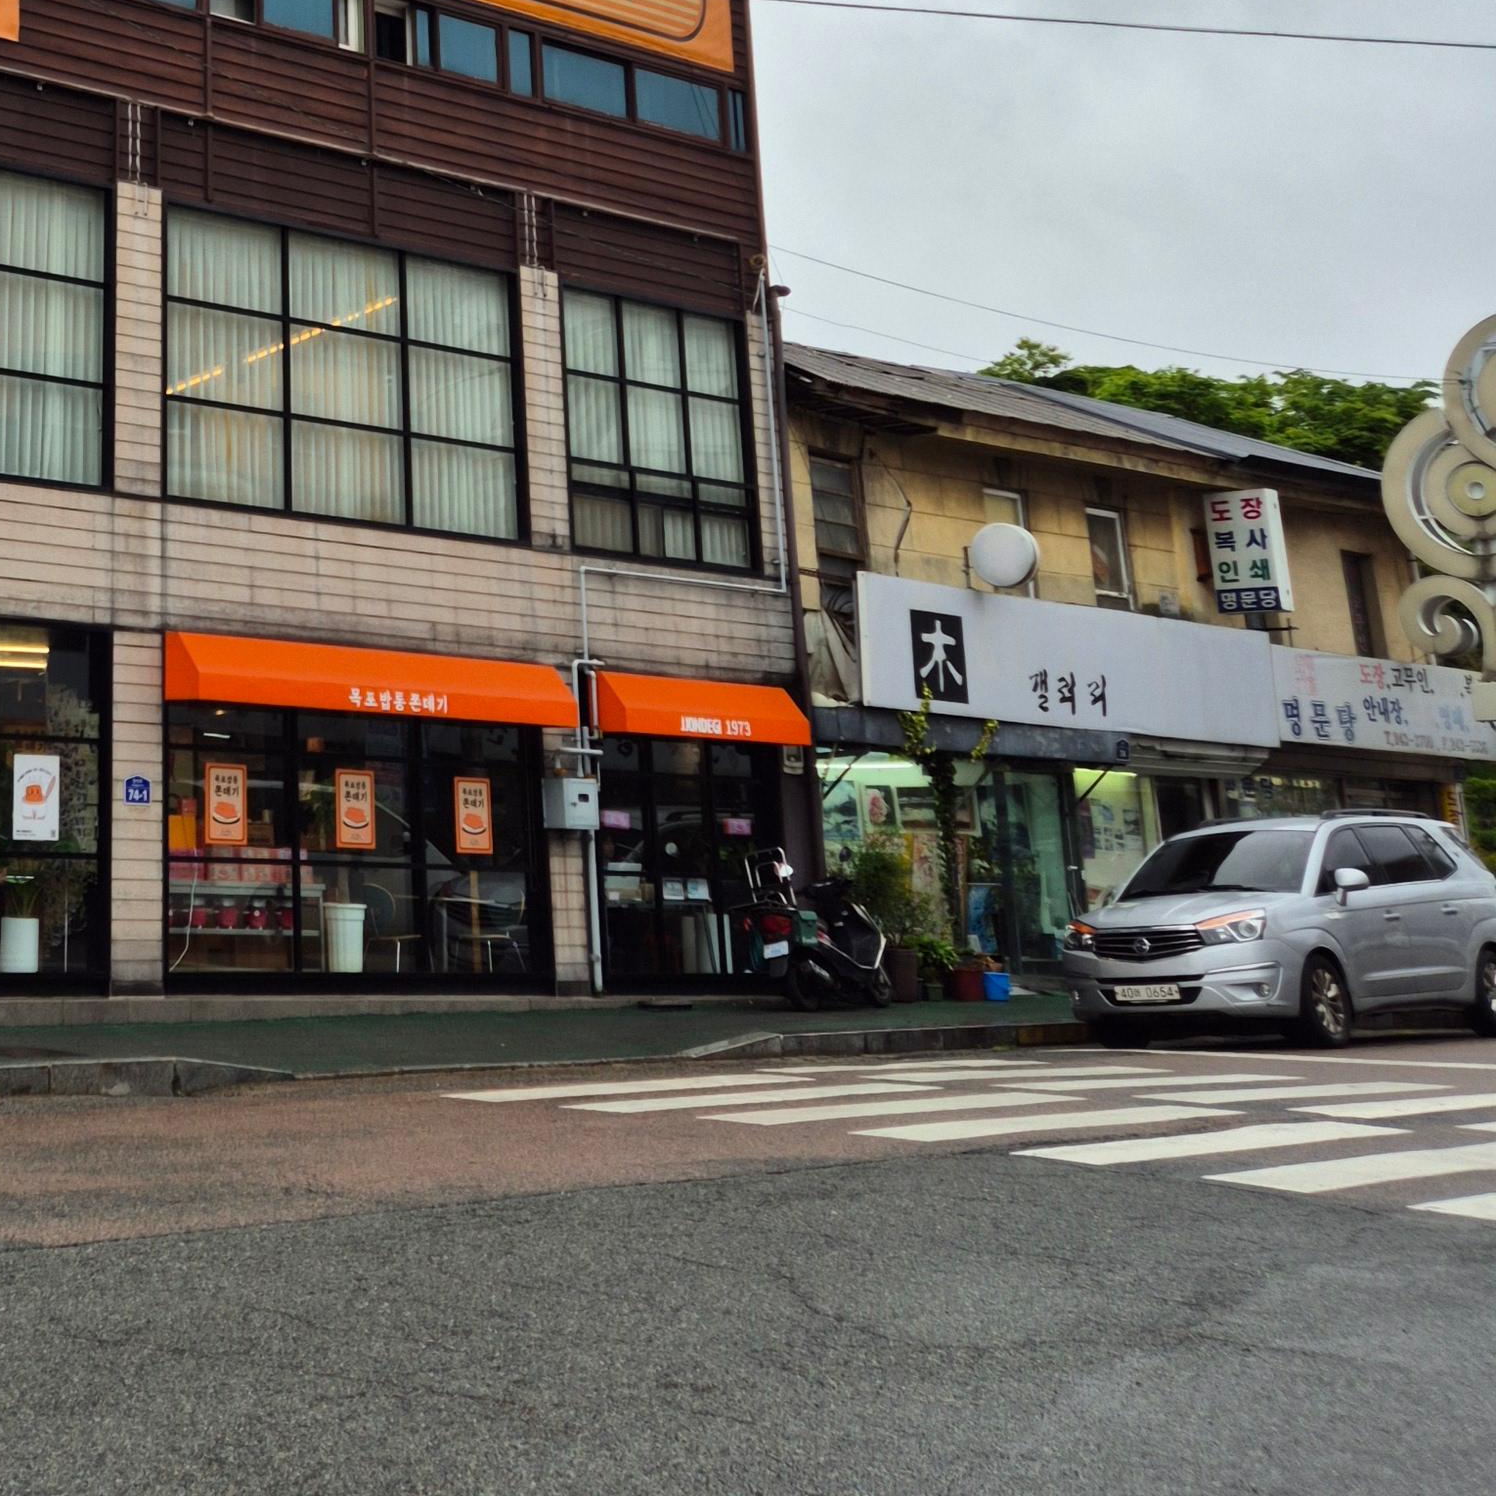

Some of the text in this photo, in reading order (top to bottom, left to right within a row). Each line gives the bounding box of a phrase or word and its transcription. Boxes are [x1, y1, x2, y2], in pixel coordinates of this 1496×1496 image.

[1210, 497, 1263, 522] 도장
[1215, 528, 1267, 552] 복사
[1218, 558, 1271, 584] 인쇄
[1220, 590, 1277, 610] 명문당
[919, 619, 963, 693] 木
[348, 687, 448, 714] 목포밥통 쫀데기
[1029, 669, 1107, 717] 갤러리
[726, 720, 751, 737] 1973
[128, 789, 148, 801] 74-1
